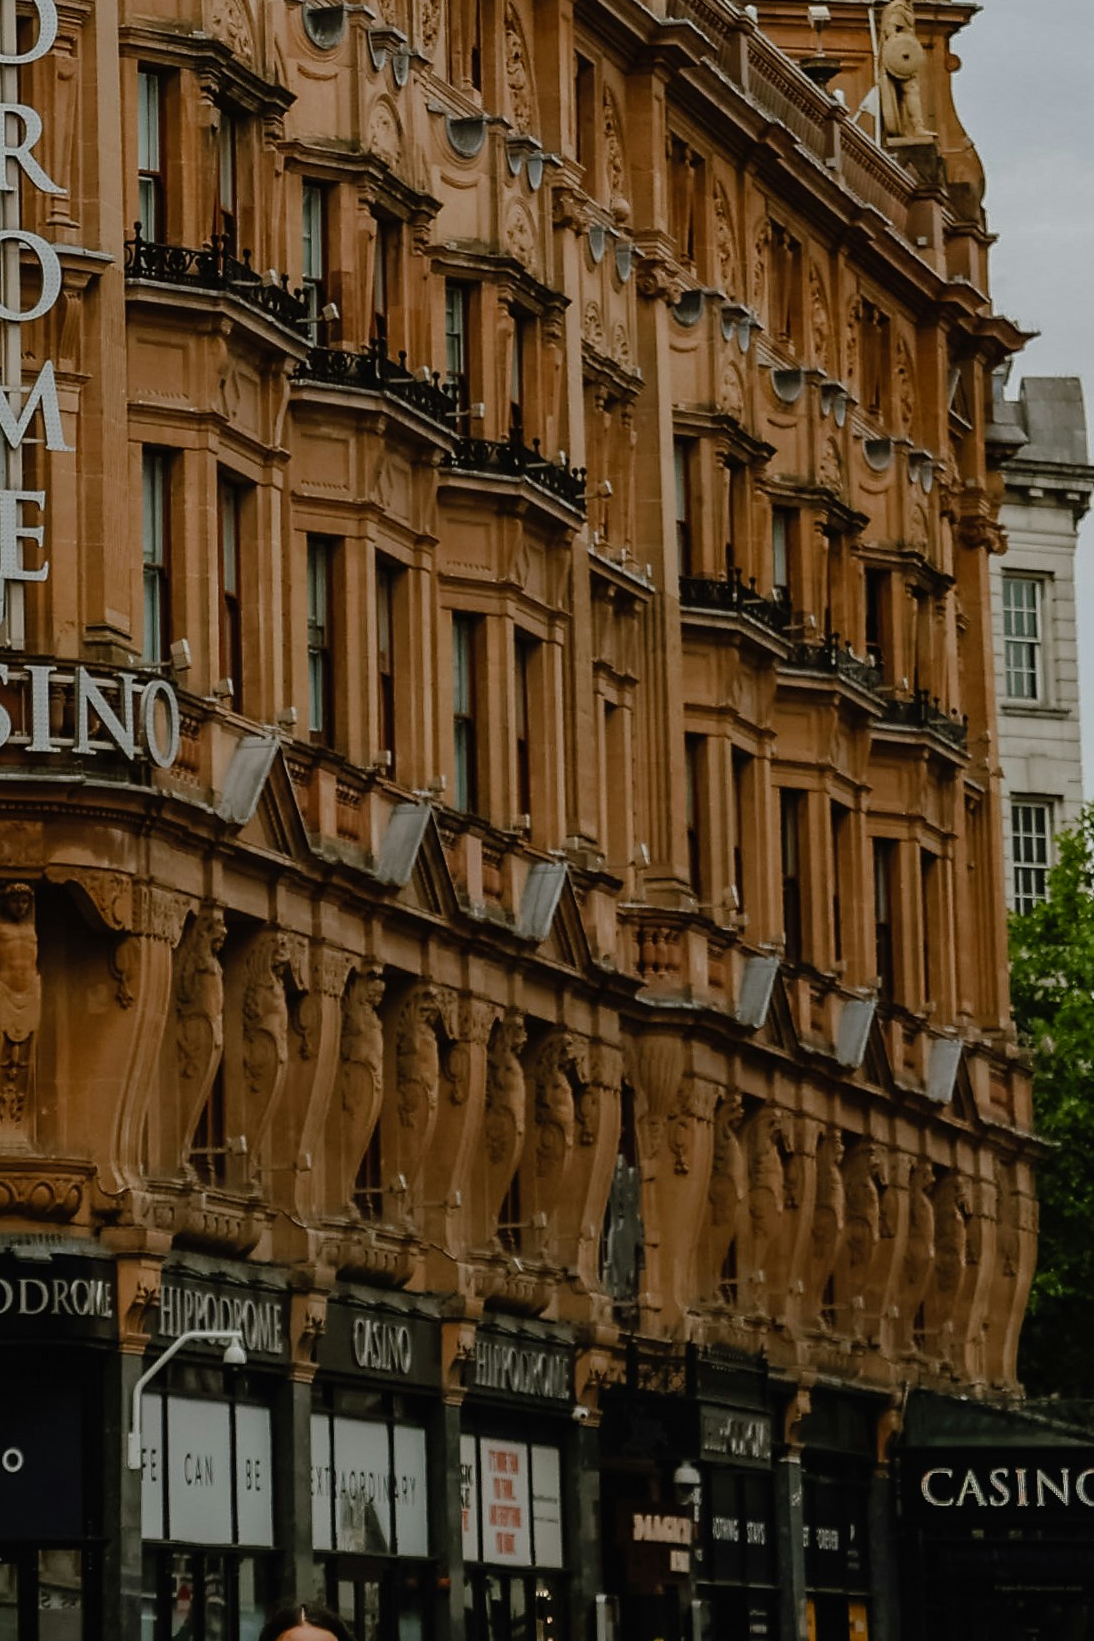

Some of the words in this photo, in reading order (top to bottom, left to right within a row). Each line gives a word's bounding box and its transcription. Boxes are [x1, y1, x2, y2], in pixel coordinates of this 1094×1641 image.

[158, 1285, 283, 1354] HIPPODROME
[353, 1318, 413, 1375] CASINO
[184, 1453, 213, 1487] CAN
[245, 1459, 260, 1491] BE
[310, 1464, 416, 1506] EXTAORDINARY
